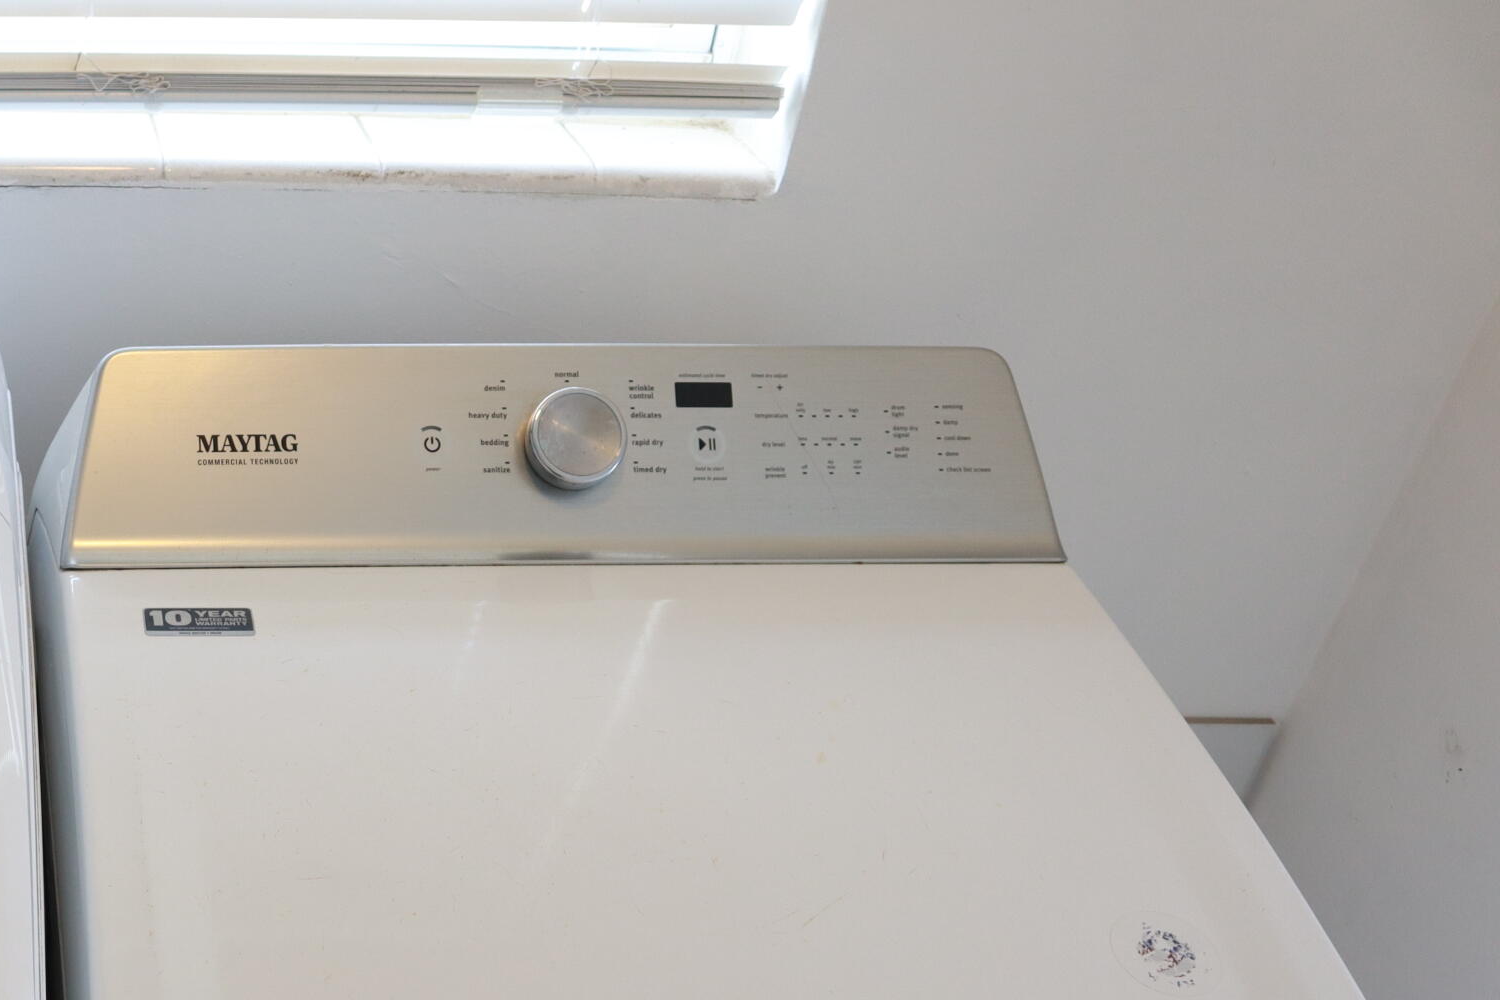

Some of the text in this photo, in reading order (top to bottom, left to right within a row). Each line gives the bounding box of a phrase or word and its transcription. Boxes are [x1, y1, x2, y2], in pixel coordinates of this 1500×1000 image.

[468, 412, 507, 420] heavy duty
[197, 434, 298, 453] MAYTAG
[480, 439, 509, 447] bedding
[631, 439, 664, 447] rapid dry
[655, 466, 667, 474] dry
[149, 610, 192, 626] 10
